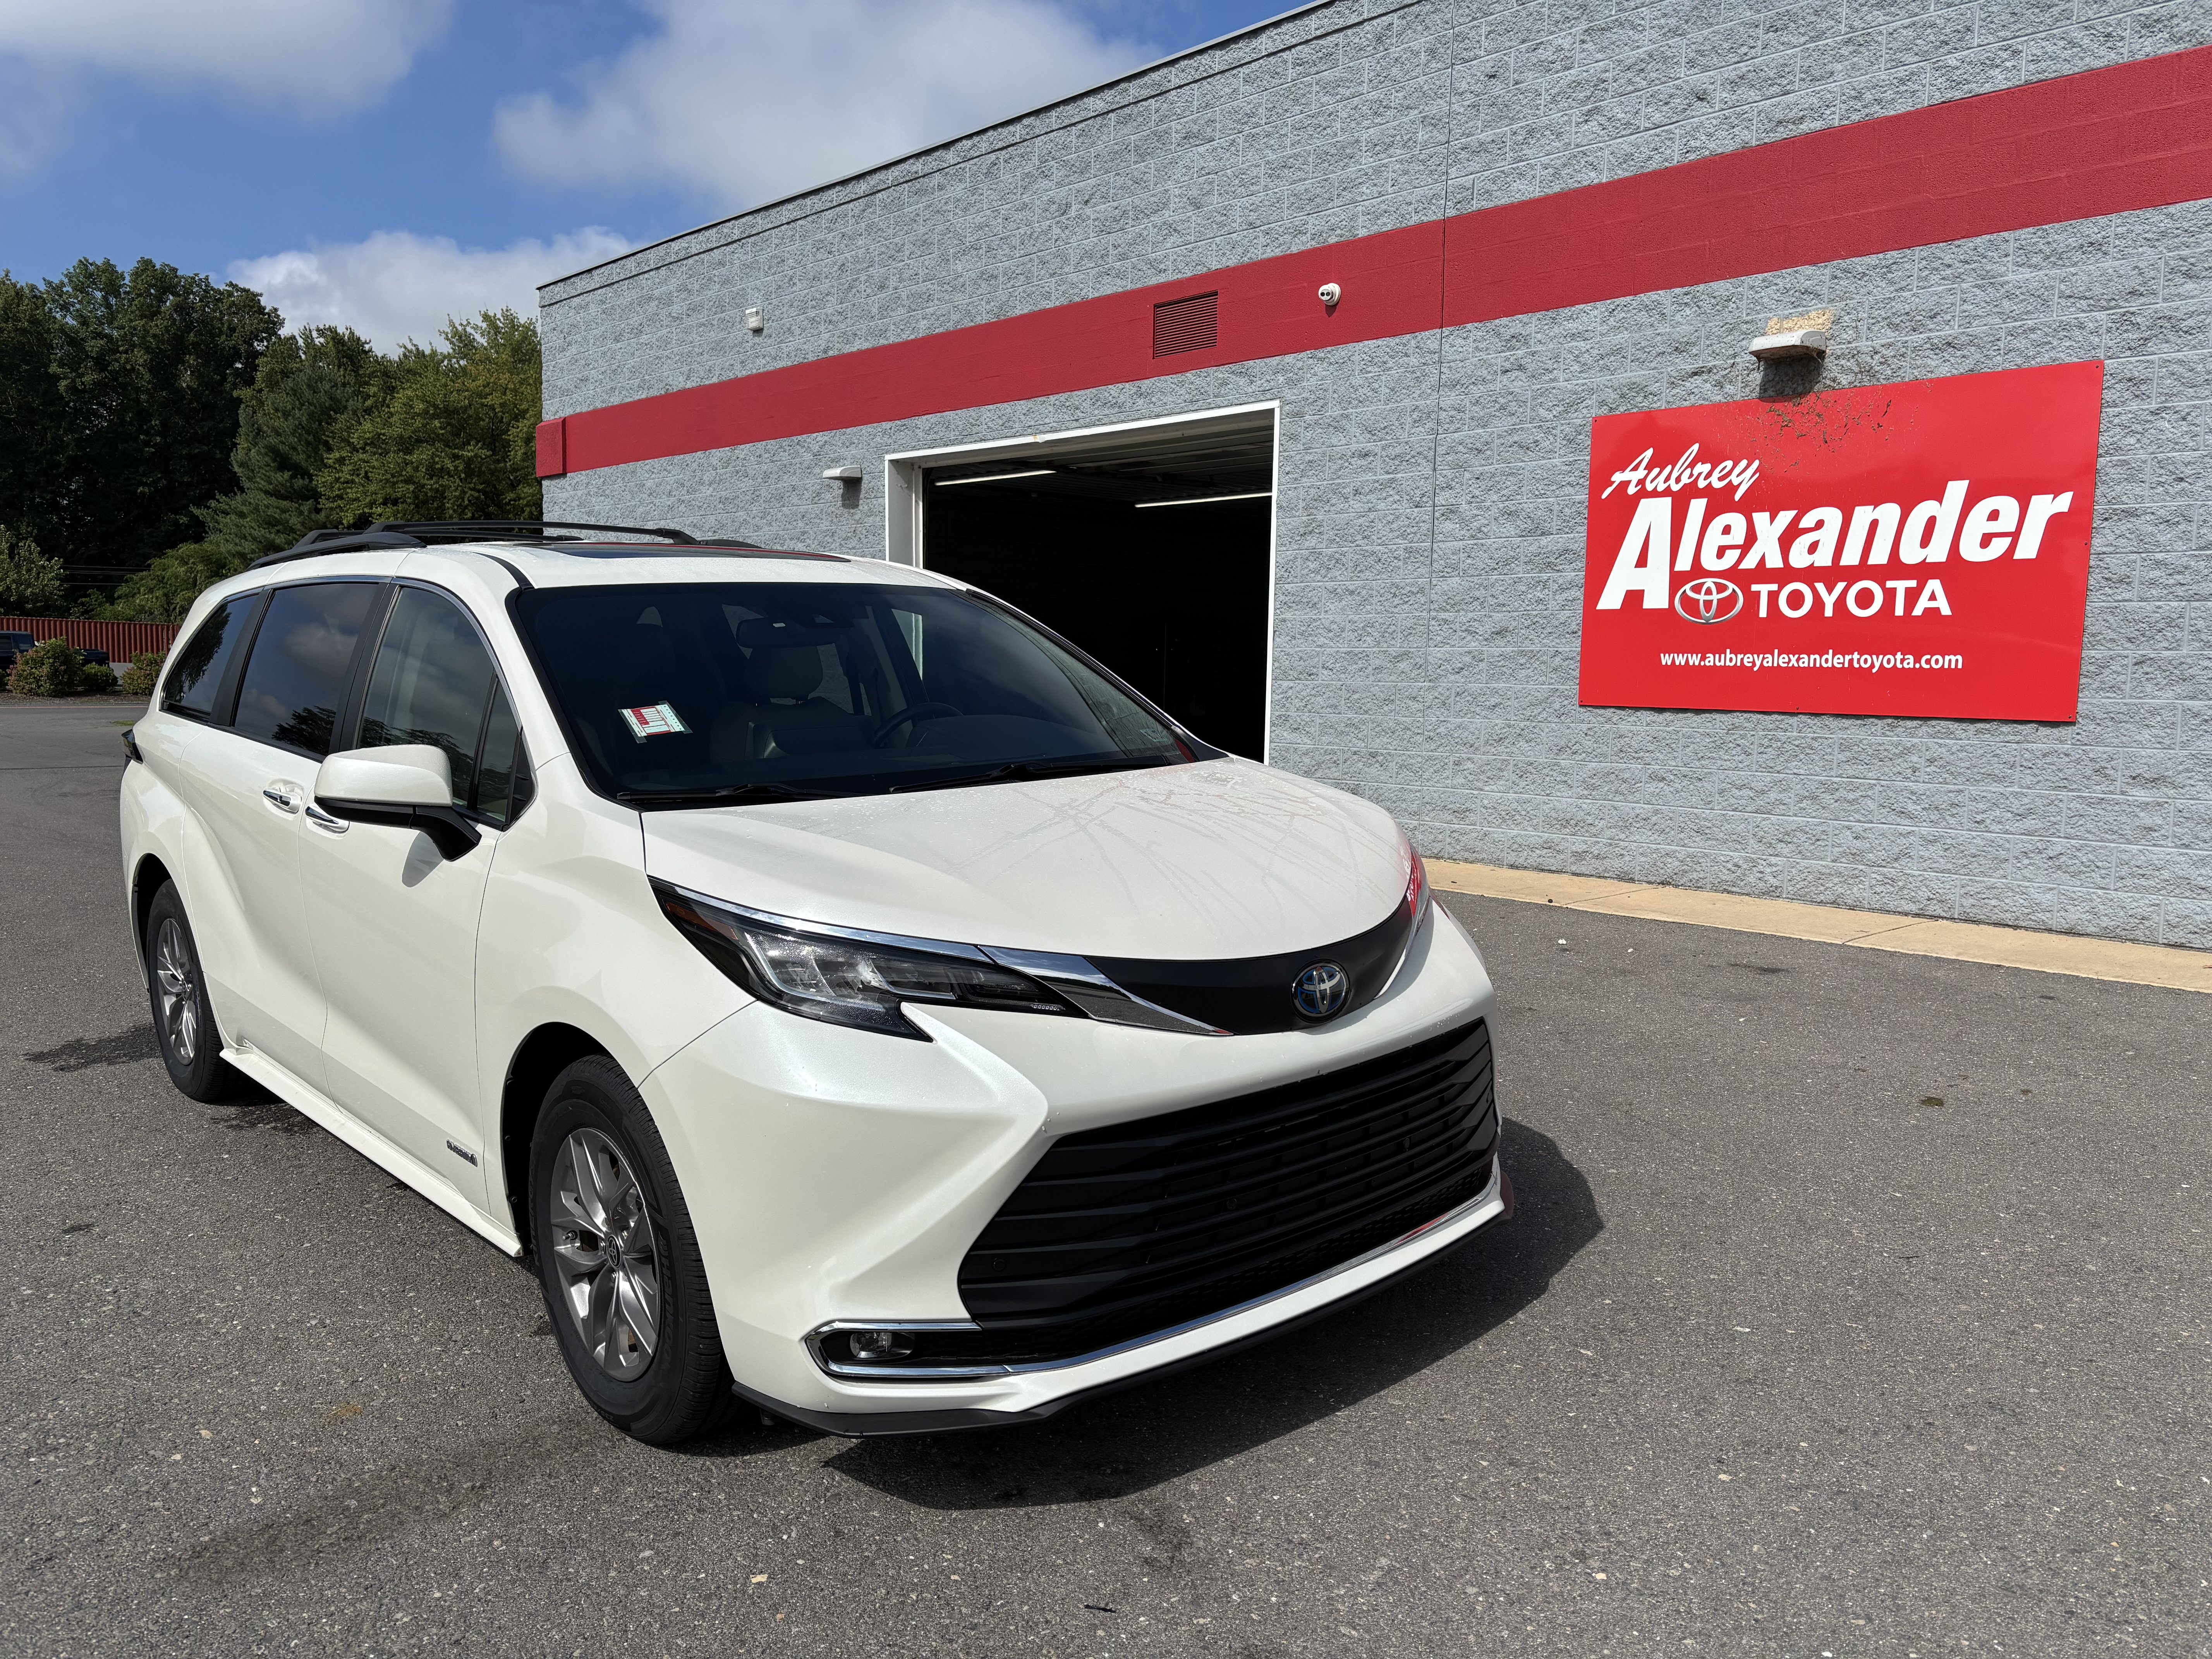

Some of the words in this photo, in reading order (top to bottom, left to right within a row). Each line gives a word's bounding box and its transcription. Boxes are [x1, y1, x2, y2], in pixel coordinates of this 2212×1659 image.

[1601, 443, 1760, 501] Aubrey
[1596, 479, 2074, 610] Alexander
[1751, 579, 1952, 618] TOYOTA
[1660, 649, 1963, 673] www.aubreyalexandertoyota.com
